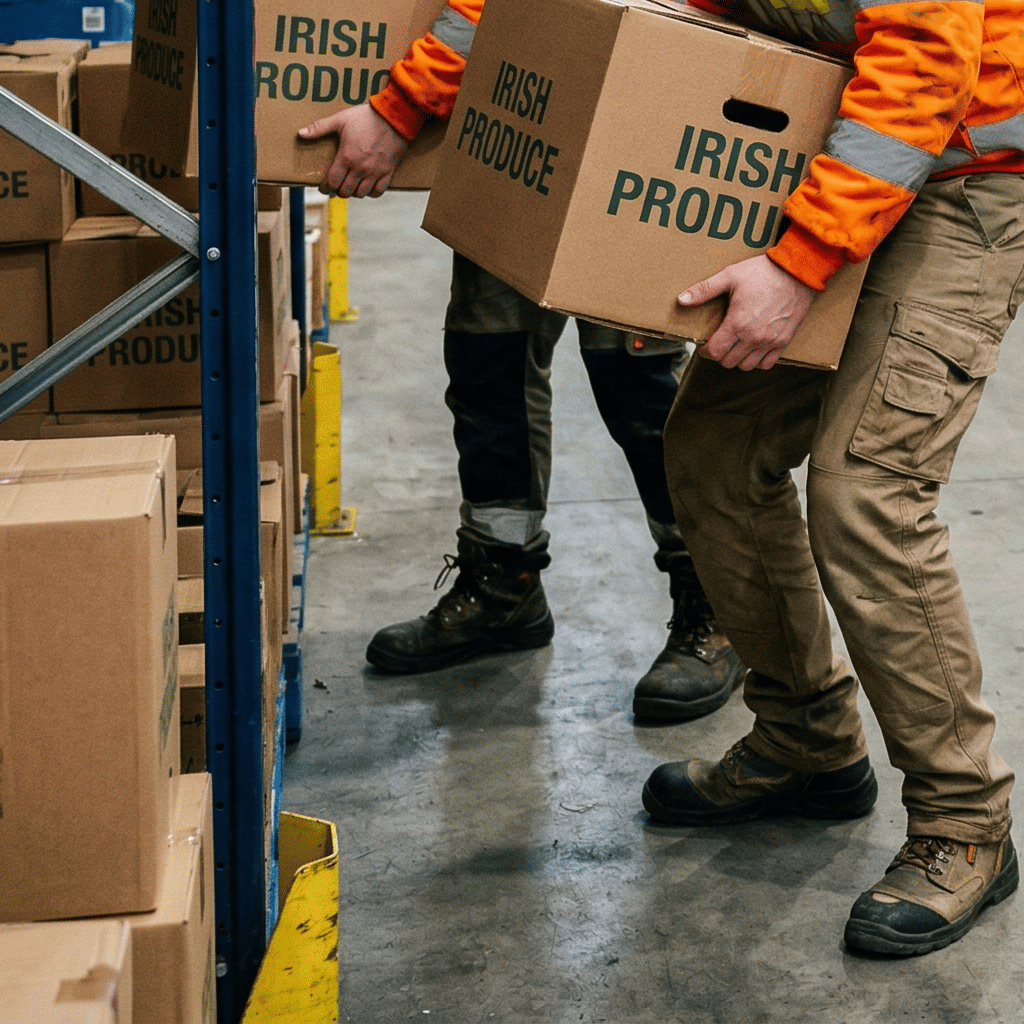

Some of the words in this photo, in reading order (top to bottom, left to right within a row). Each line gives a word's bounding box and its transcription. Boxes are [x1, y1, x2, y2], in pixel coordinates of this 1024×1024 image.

[274, 14, 388, 60] IRISH
[490, 59, 554, 125] IRISH
[456, 106, 560, 197] PRODUCE
[674, 124, 807, 197] IRISH
[606, 169, 779, 249] PRODU
